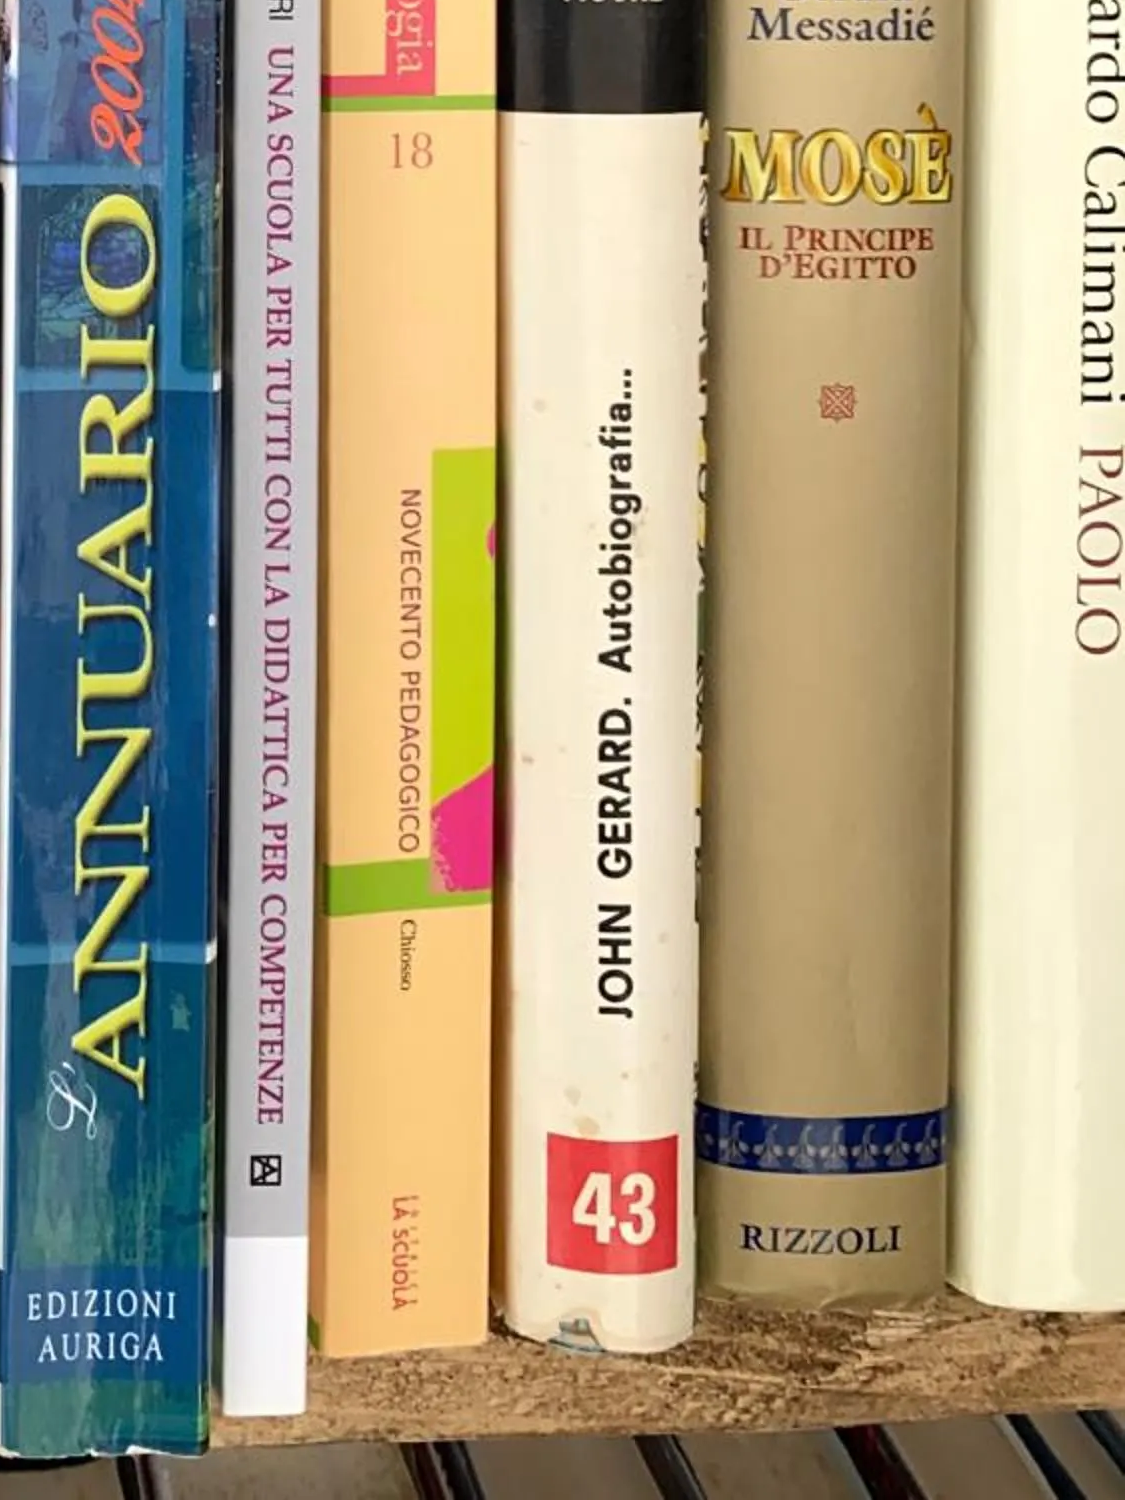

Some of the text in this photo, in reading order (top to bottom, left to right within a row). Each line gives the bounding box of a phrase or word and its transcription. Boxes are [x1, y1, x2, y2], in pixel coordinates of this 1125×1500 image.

[747, 6, 935, 42] Messadié
[391, 131, 432, 170] 18
[722, 102, 954, 204] MOSÈ
[739, 224, 934, 251] IL PRINCIPE
[1080, 145, 1125, 406] Calimani
[257, 46, 293, 1126] UNA SCUOLA PER TUTTI CON LA DIDATTICA PER COMPETENZE
[1074, 446, 1124, 656] PAOLO
[398, 489, 422, 852] NOVECENTO PEDAGOGICO
[597, 696, 633, 880] GERARD.
[399, 919, 417, 991] Chiosso
[597, 902, 634, 1019] JOHN
[572, 1171, 656, 1246] 43
[739, 1223, 901, 1255] RIZZOLI
[27, 1290, 175, 1320] EDIZIONI
[38, 1333, 163, 1362] AURIGA
